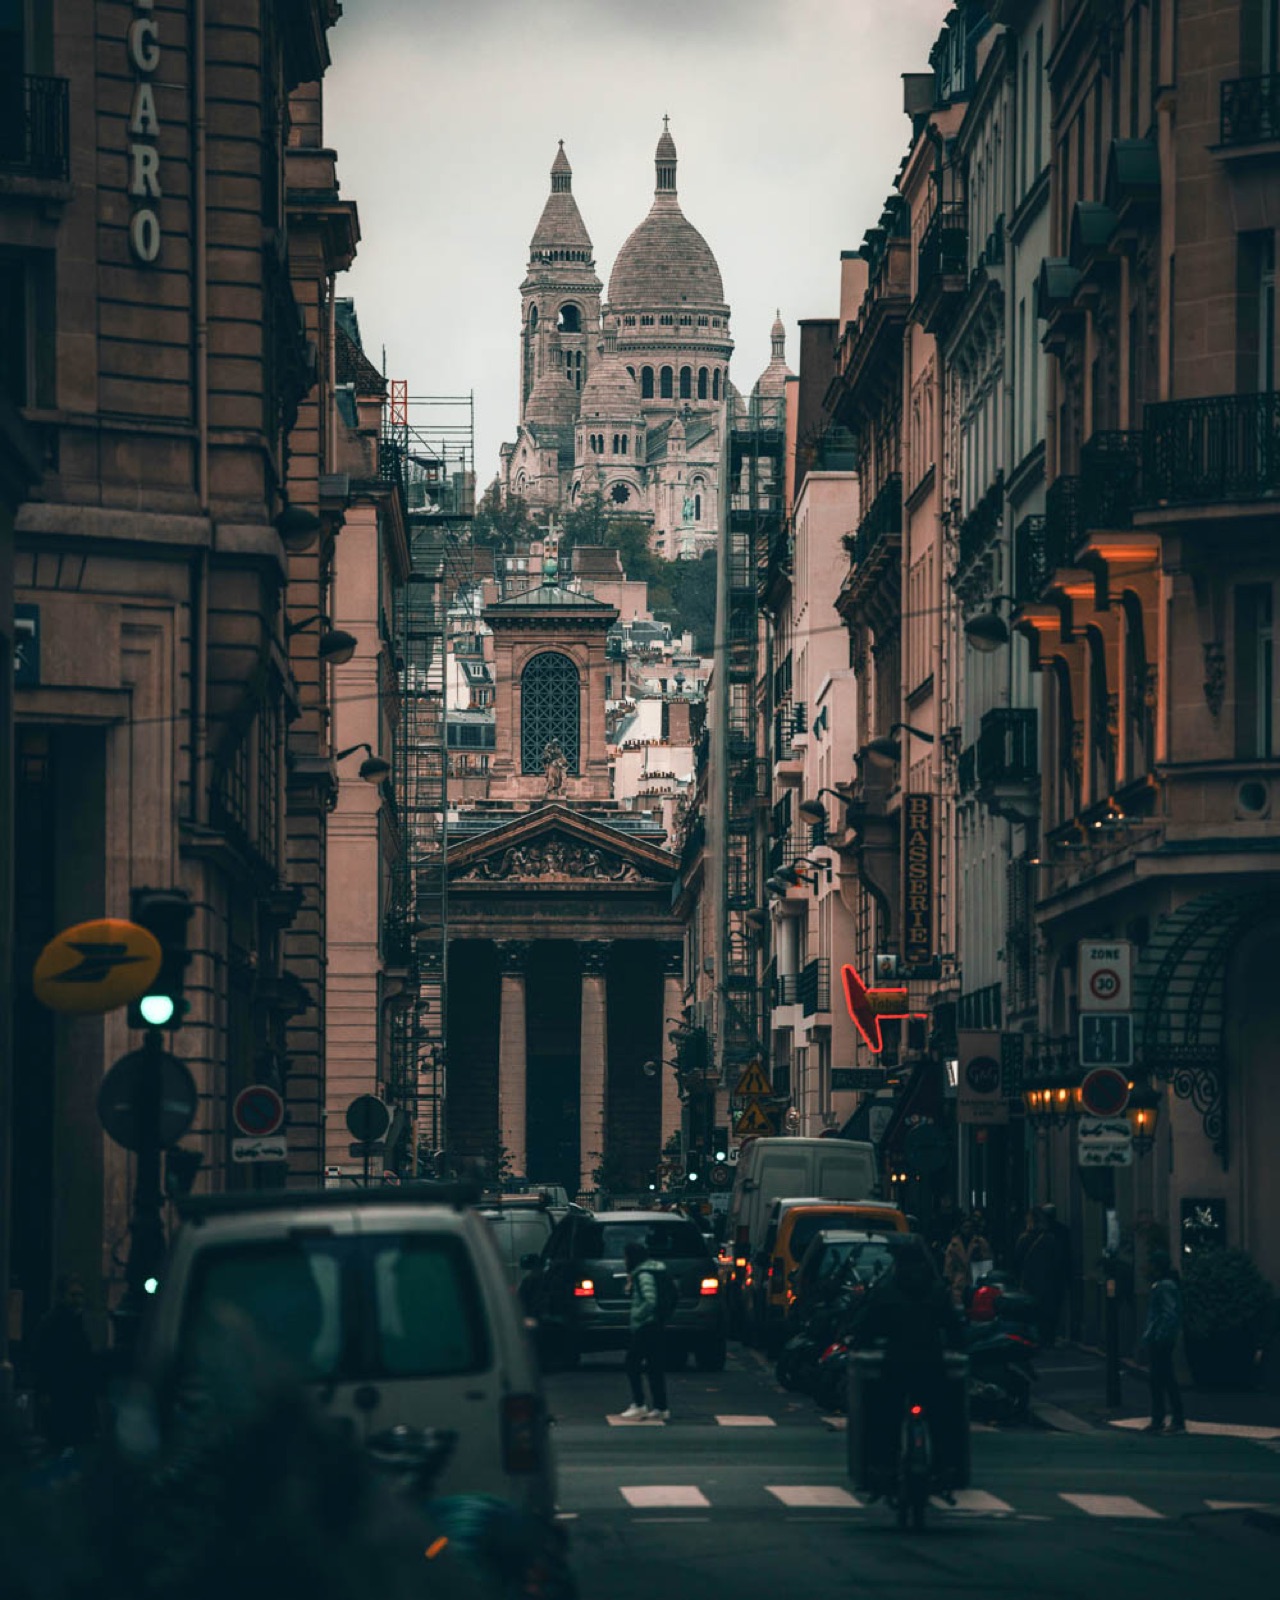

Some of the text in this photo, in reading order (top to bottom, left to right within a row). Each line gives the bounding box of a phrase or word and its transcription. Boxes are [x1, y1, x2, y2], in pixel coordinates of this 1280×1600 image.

[130, 0, 161, 262] GARO
[909, 798, 929, 944] BRASSERIE
[1090, 949, 1121, 960] ZONE
[1097, 978, 1113, 990] 30
